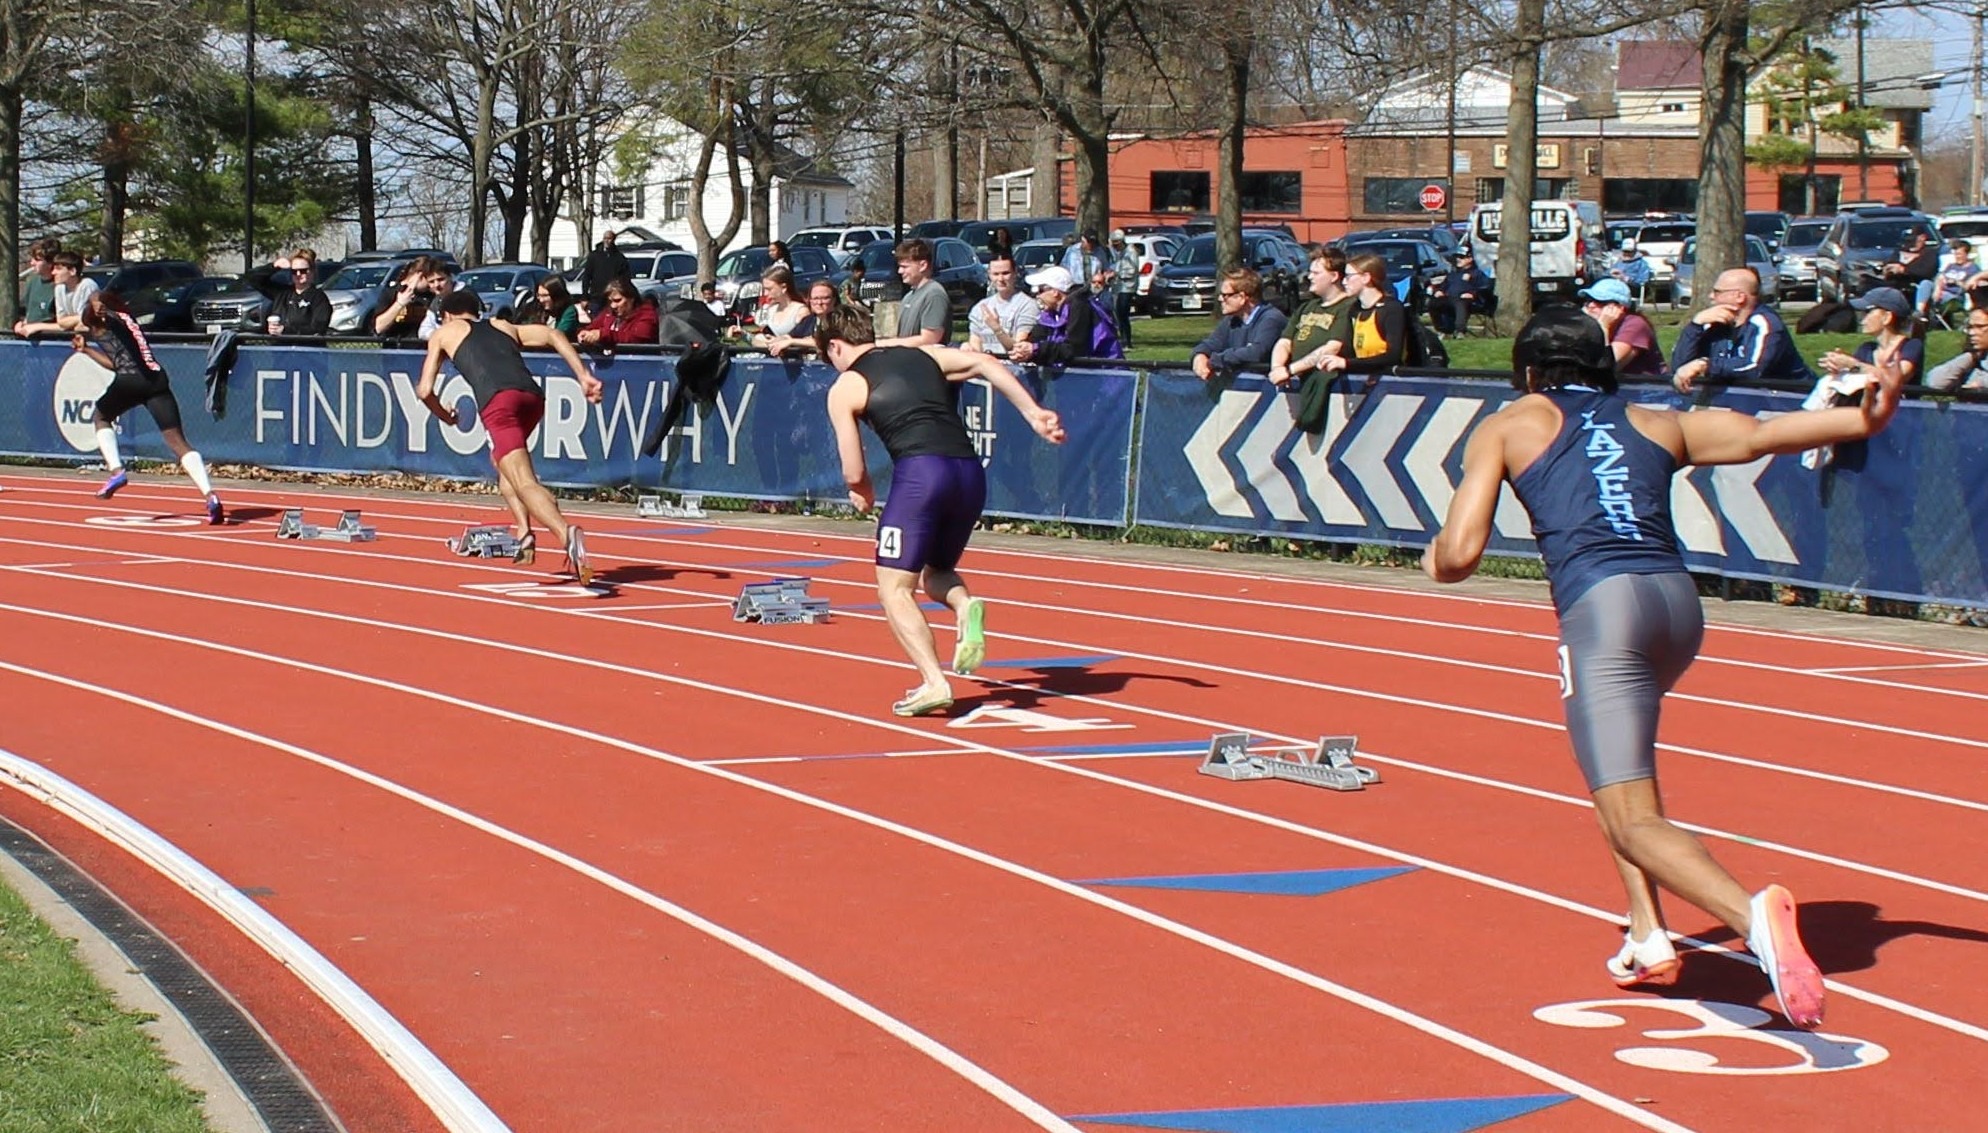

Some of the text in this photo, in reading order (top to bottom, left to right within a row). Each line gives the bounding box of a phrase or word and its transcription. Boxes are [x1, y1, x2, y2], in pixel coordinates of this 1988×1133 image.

[1421, 192, 1442, 203] STOP
[883, 530, 896, 555] 4
[946, 704, 1137, 732] 4
[1532, 998, 1890, 1075] 3
